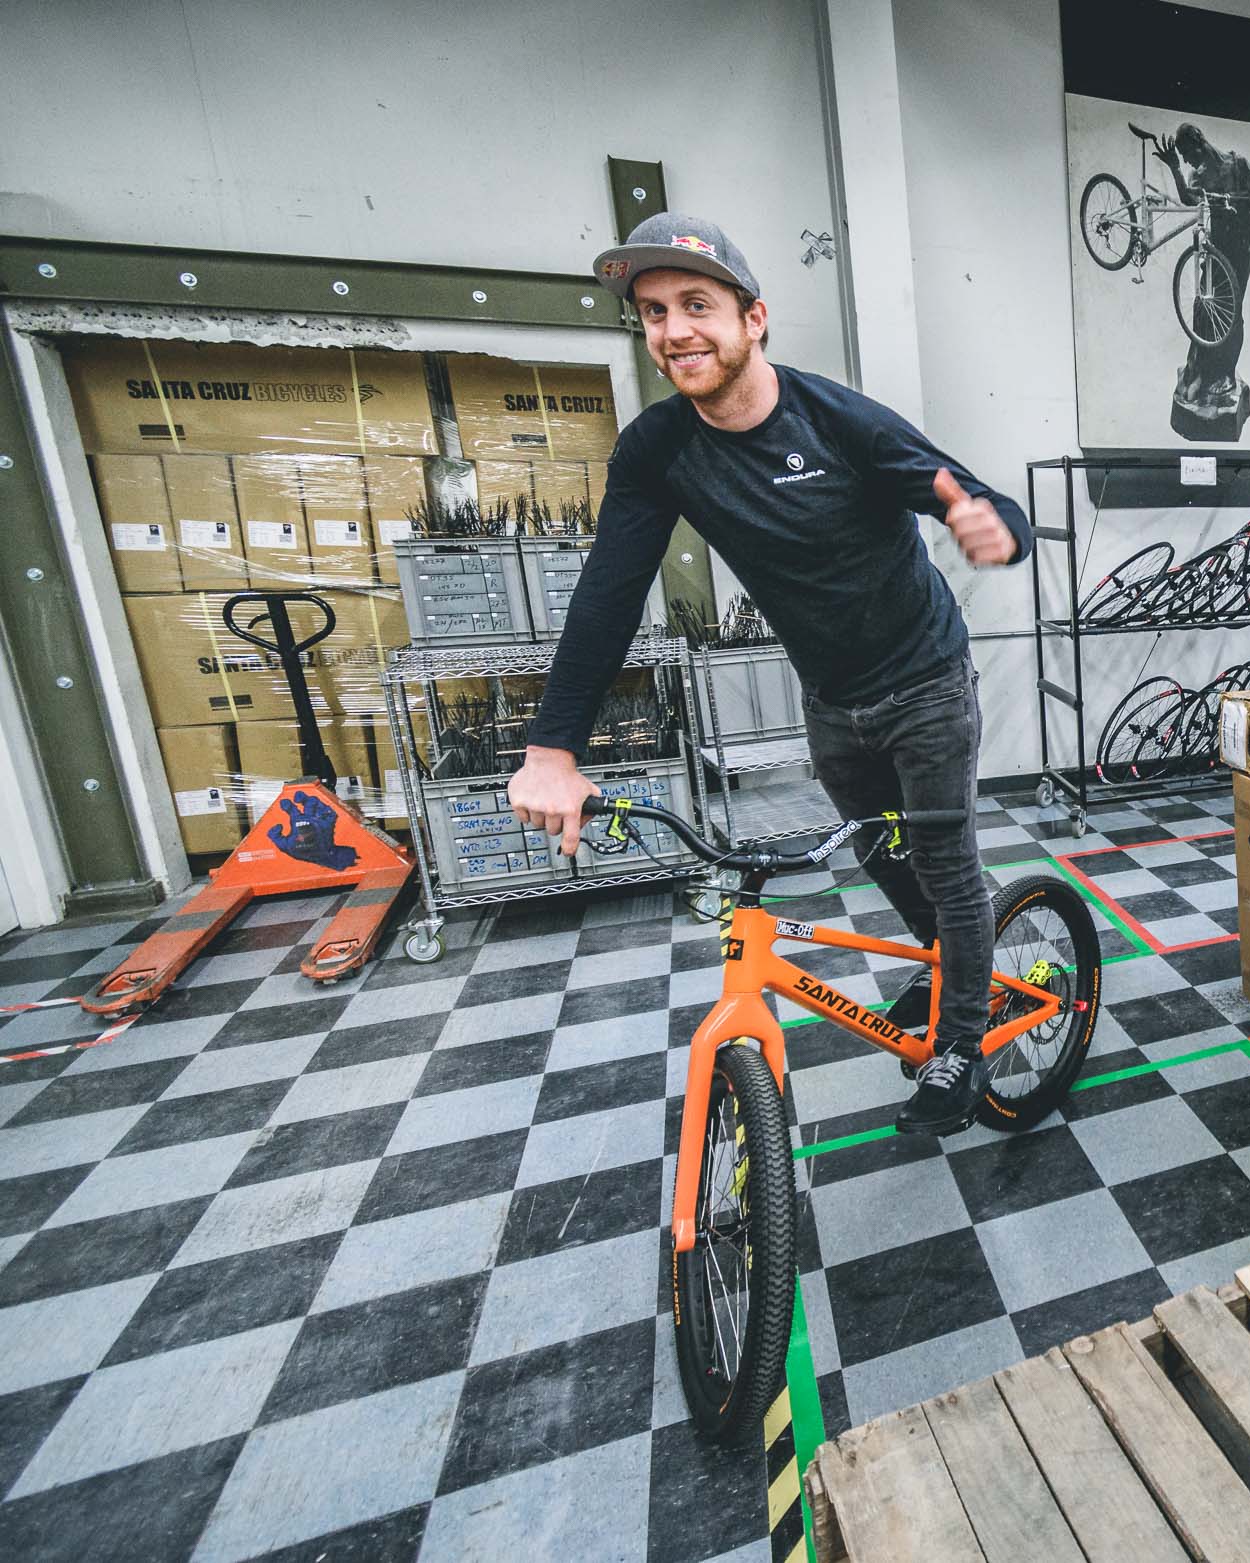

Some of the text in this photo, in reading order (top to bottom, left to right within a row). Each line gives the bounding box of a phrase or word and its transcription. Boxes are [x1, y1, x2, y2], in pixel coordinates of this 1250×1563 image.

[198, 382, 252, 400] CRUZ
[254, 383, 347, 403] BICYCLES
[561, 396, 604, 413] CRUZ
[773, 469, 826, 484] ENDURA
[808, 820, 859, 863] Inspired
[777, 921, 813, 938] Muc-Off
[793, 976, 906, 1045] SANTA CRUZ
